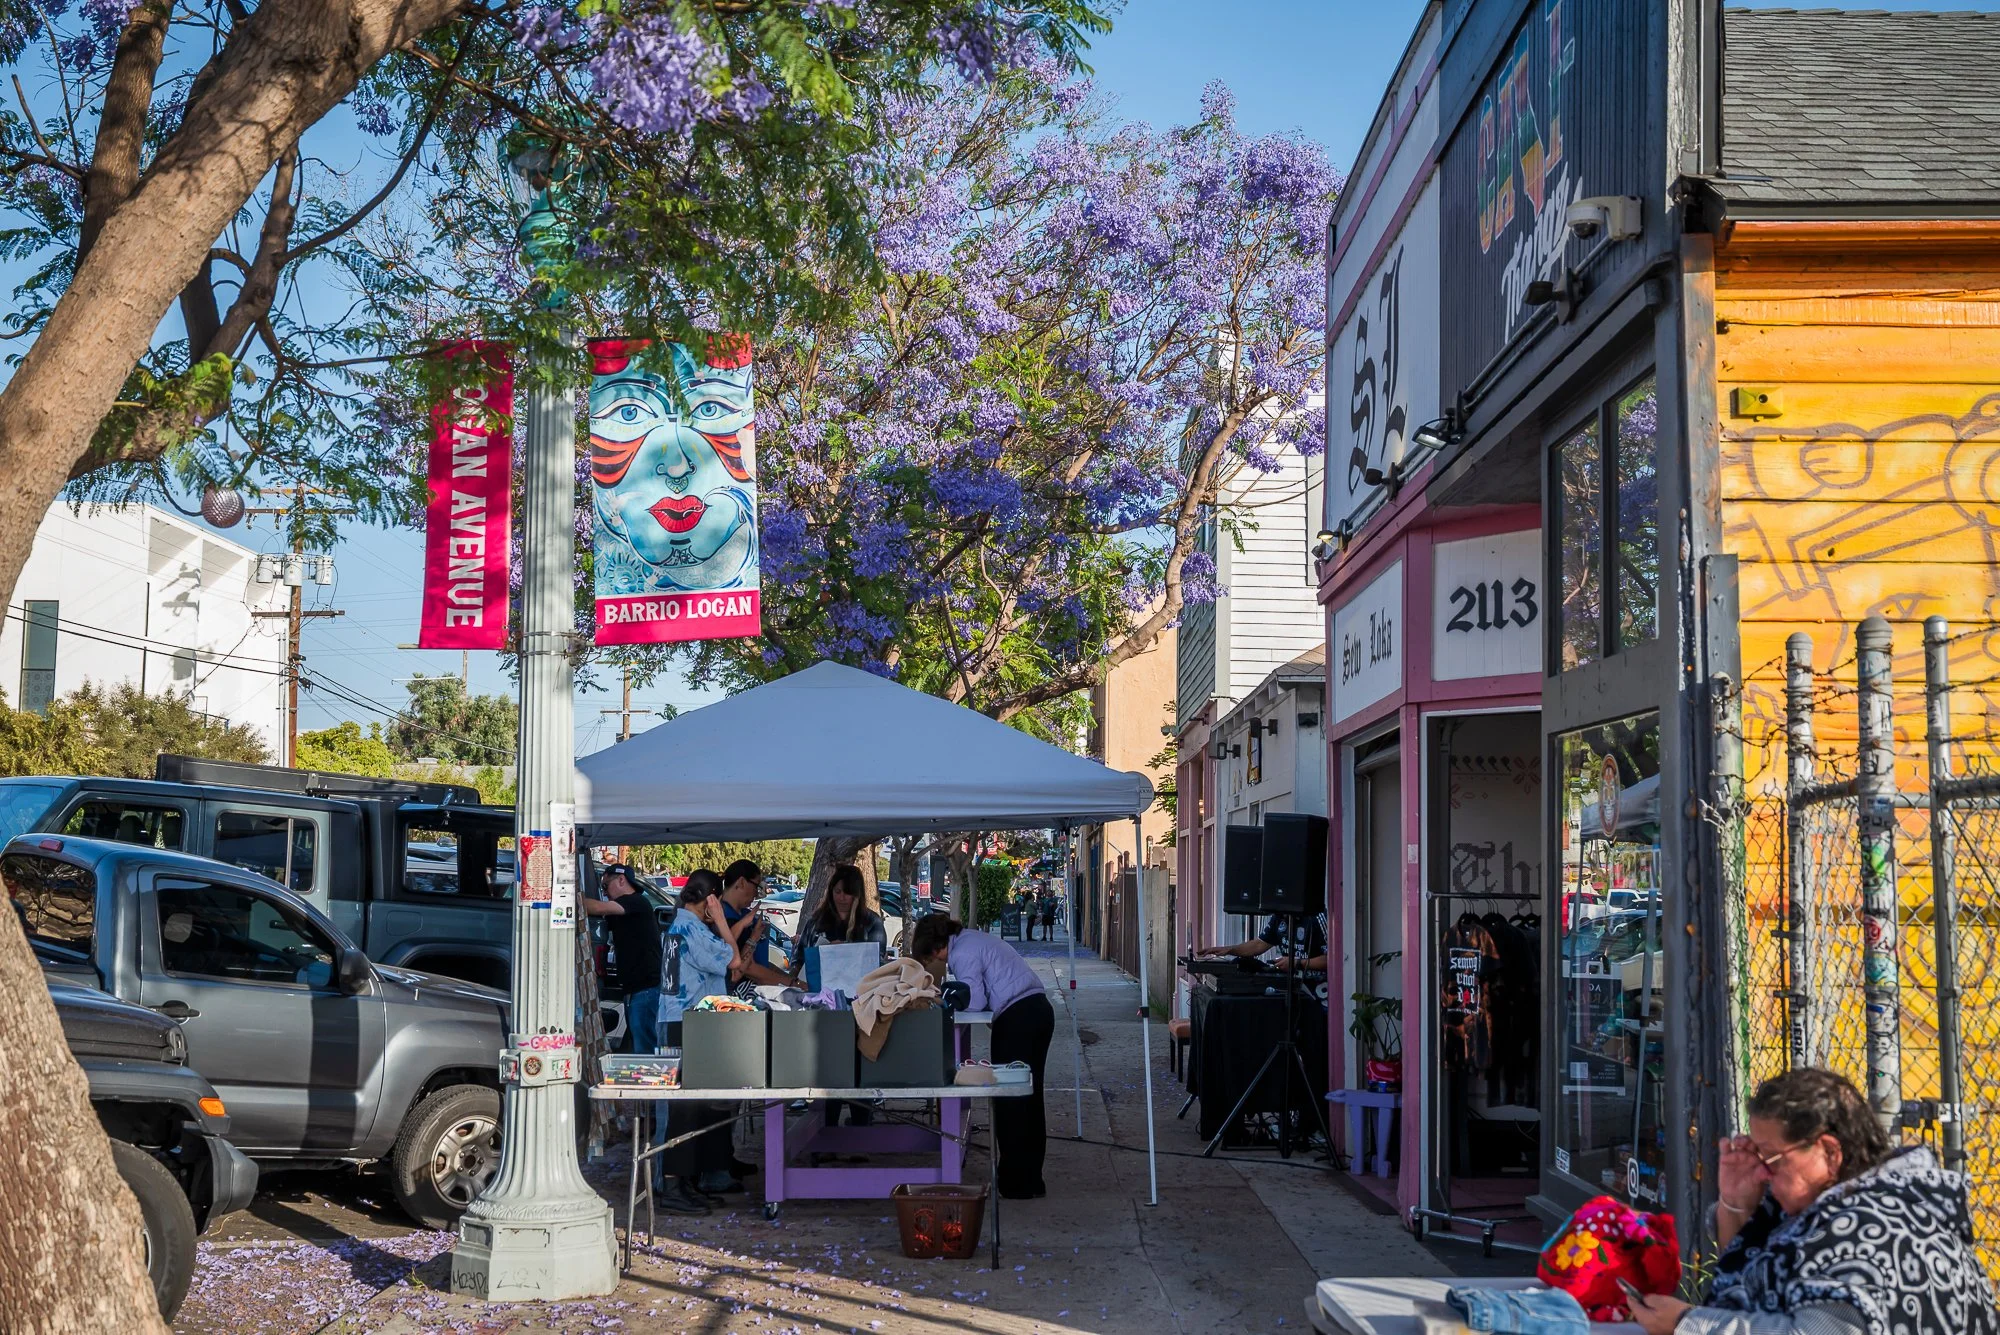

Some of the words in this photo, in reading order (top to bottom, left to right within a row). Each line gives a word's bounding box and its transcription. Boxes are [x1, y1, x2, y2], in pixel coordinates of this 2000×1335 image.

[445, 489, 487, 628] AVENUE
[604, 600, 681, 625] BARRIO
[686, 595, 753, 619] LOGAN
[1445, 576, 1539, 633] 2113
[1369, 606, 1393, 669] Loka
[1450, 840, 1541, 901] Th
